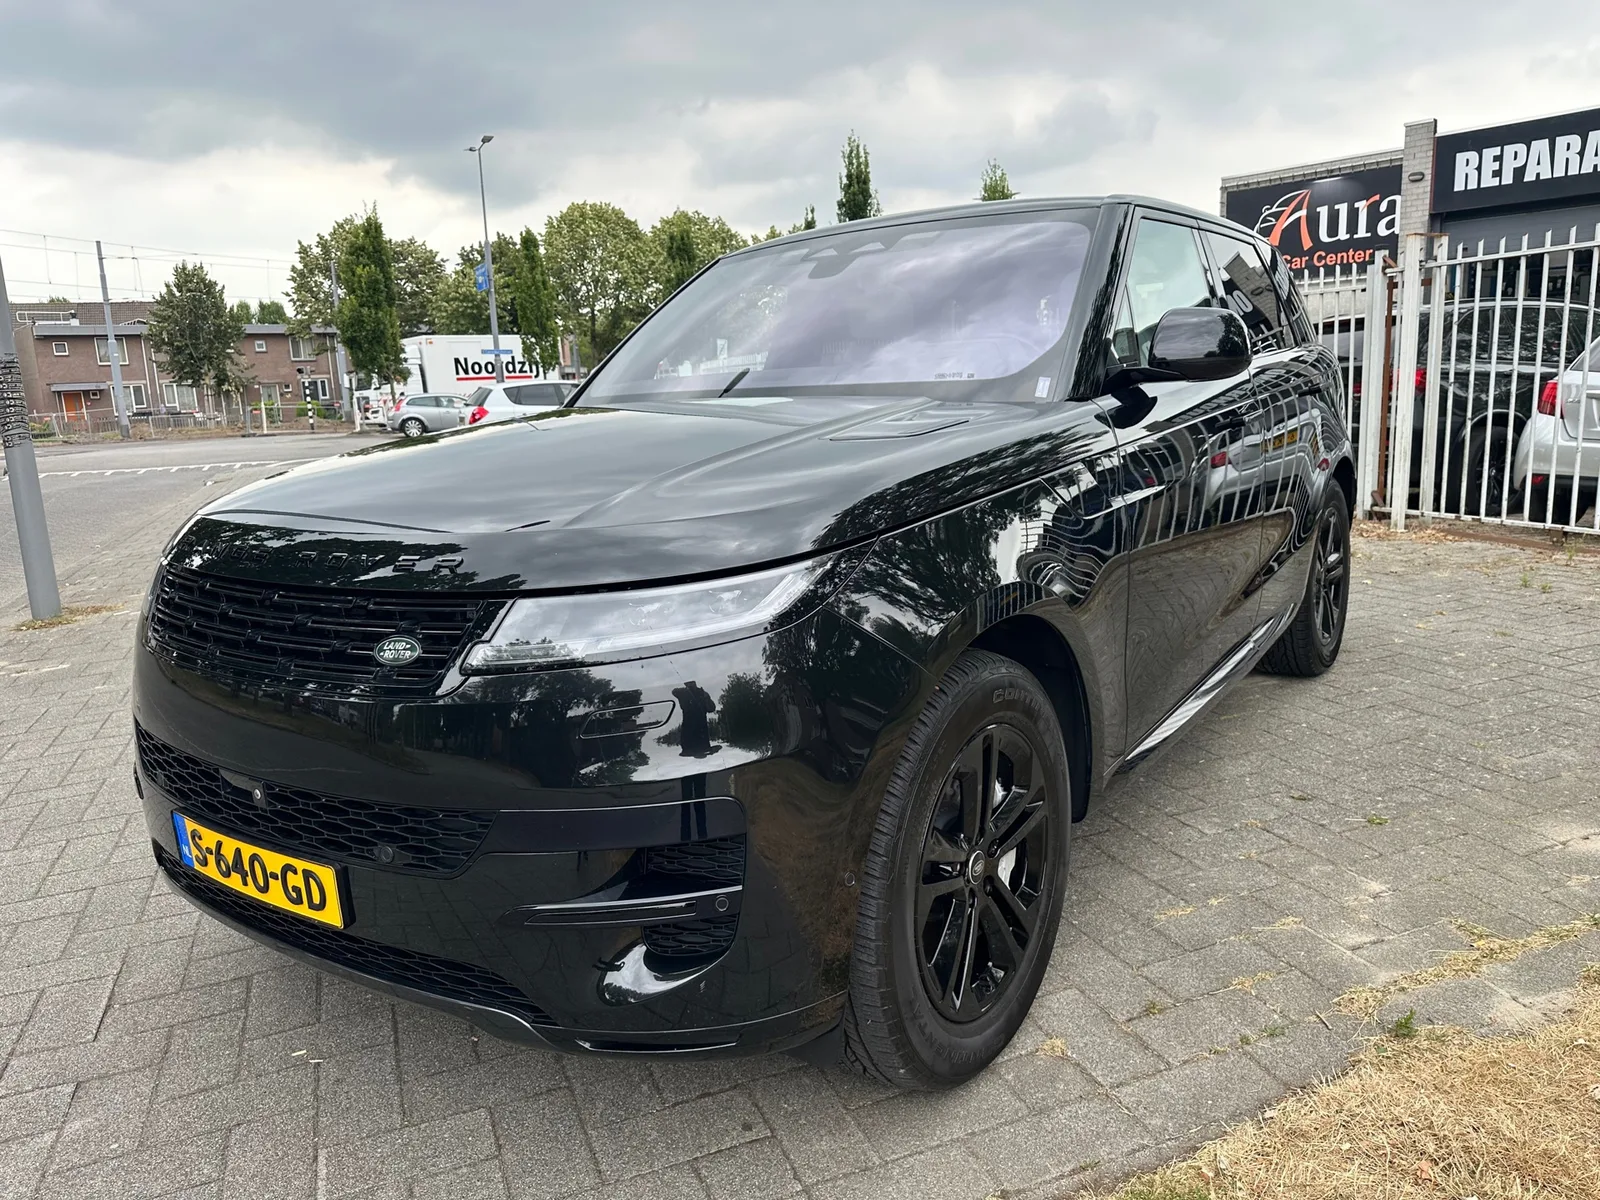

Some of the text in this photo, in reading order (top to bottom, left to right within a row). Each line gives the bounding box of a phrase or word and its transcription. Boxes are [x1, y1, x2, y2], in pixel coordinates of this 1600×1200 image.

[1453, 129, 1600, 192] REPARA
[1269, 189, 1401, 251] Aura
[1313, 248, 1374, 267] Center
[453, 355, 540, 379] Noodzij
[294, 550, 465, 575] ROVER
[383, 641, 406, 650] LAND
[383, 650, 412, 659] ROVER
[190, 828, 327, 912] S-640-GD
